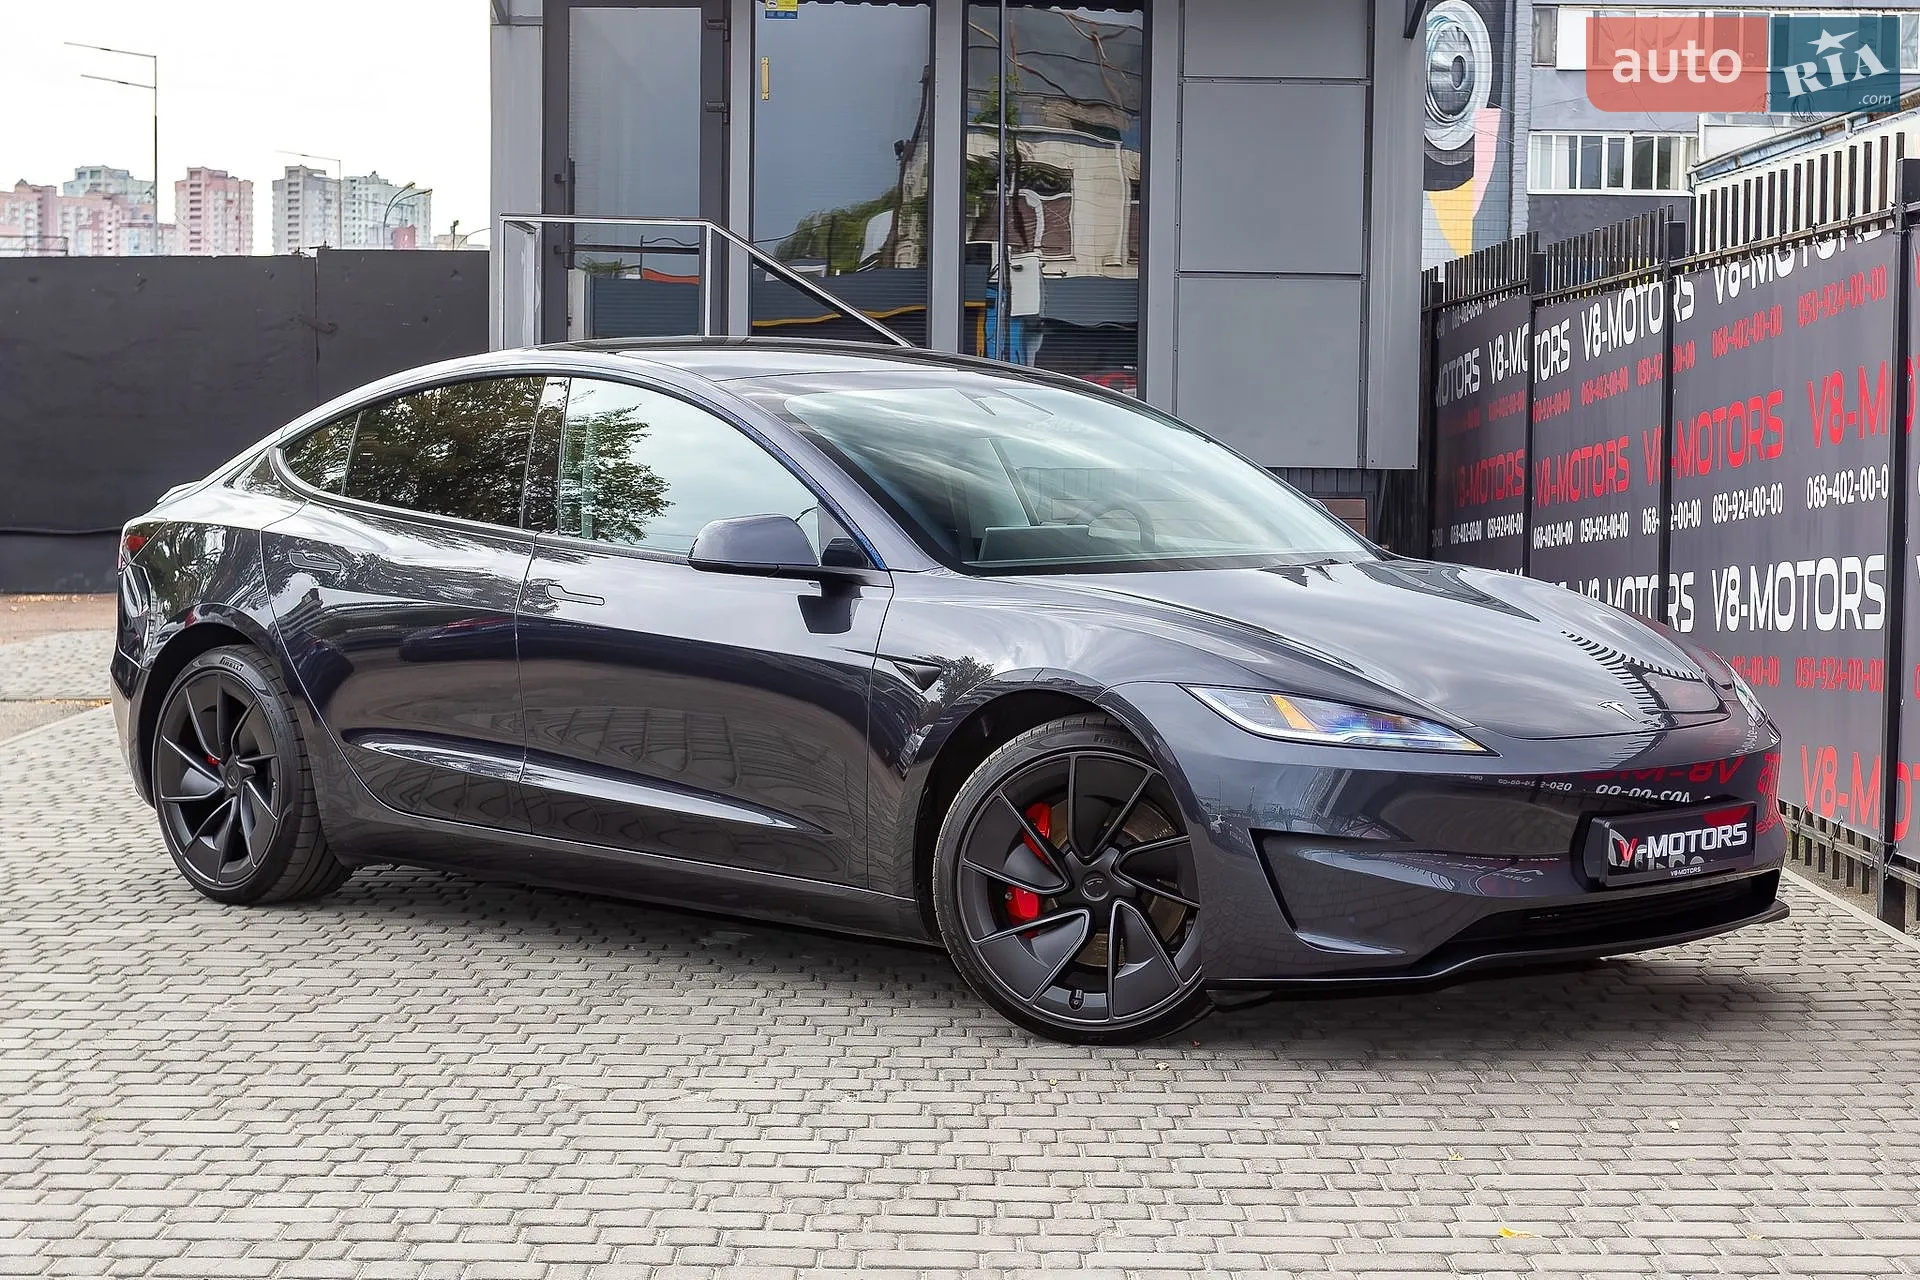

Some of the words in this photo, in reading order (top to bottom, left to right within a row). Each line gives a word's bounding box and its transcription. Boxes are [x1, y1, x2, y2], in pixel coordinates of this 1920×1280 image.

[1712, 304, 1783, 359] 068-402-00-00
[1797, 263, 1887, 328] 050-924-00-00
[1535, 436, 1631, 509] V8-MOTORS
[1580, 511, 1629, 543] 050-924-00-00
[1712, 482, 1784, 524] 050-924-00-00
[1711, 554, 1886, 633] V8-MOTORS
[1795, 656, 1884, 692] 050-924-00-00
